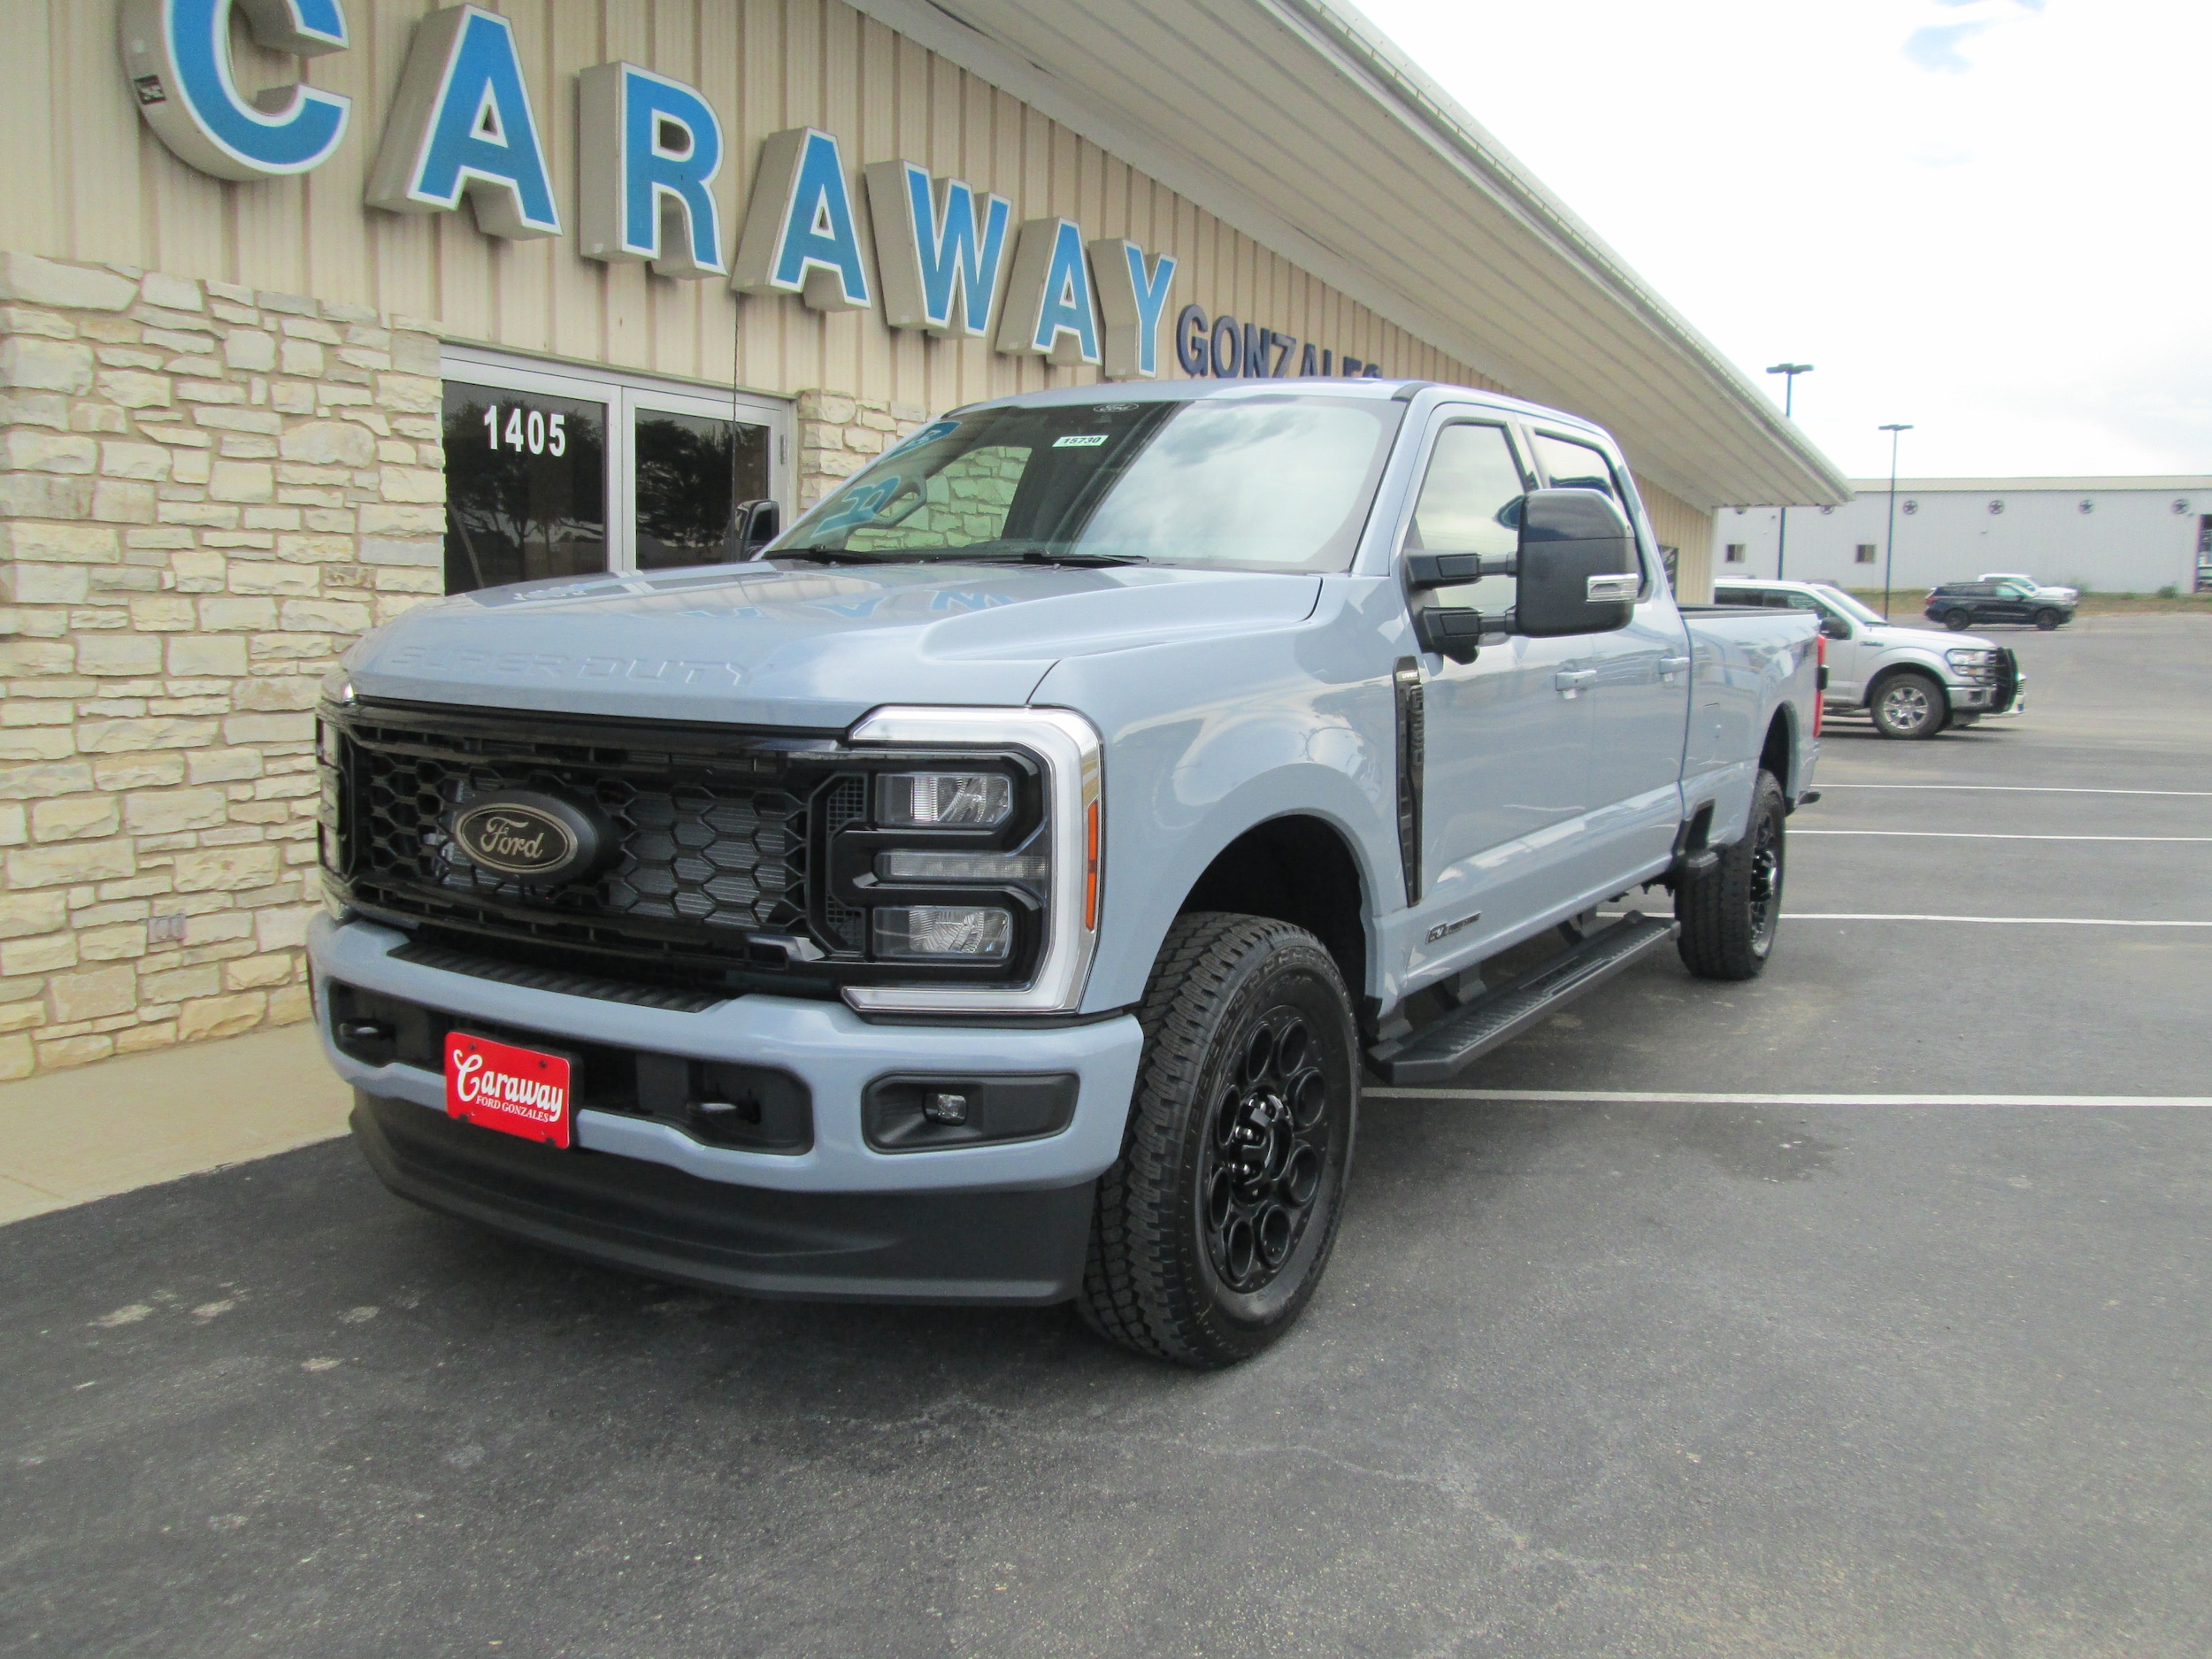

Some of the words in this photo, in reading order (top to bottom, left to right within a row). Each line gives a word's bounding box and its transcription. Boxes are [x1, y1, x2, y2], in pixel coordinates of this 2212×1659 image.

[160, 0, 1178, 379] CARAWAY
[1177, 303, 1382, 379] GONZA
[483, 404, 567, 457] 1405
[1063, 436, 1102, 445] 15730
[578, 655, 757, 687] DUTY
[480, 816, 545, 859] Ford
[453, 1049, 564, 1123] Caraway
[475, 1094, 501, 1110] FORD
[502, 1102, 549, 1123] GONZALES
